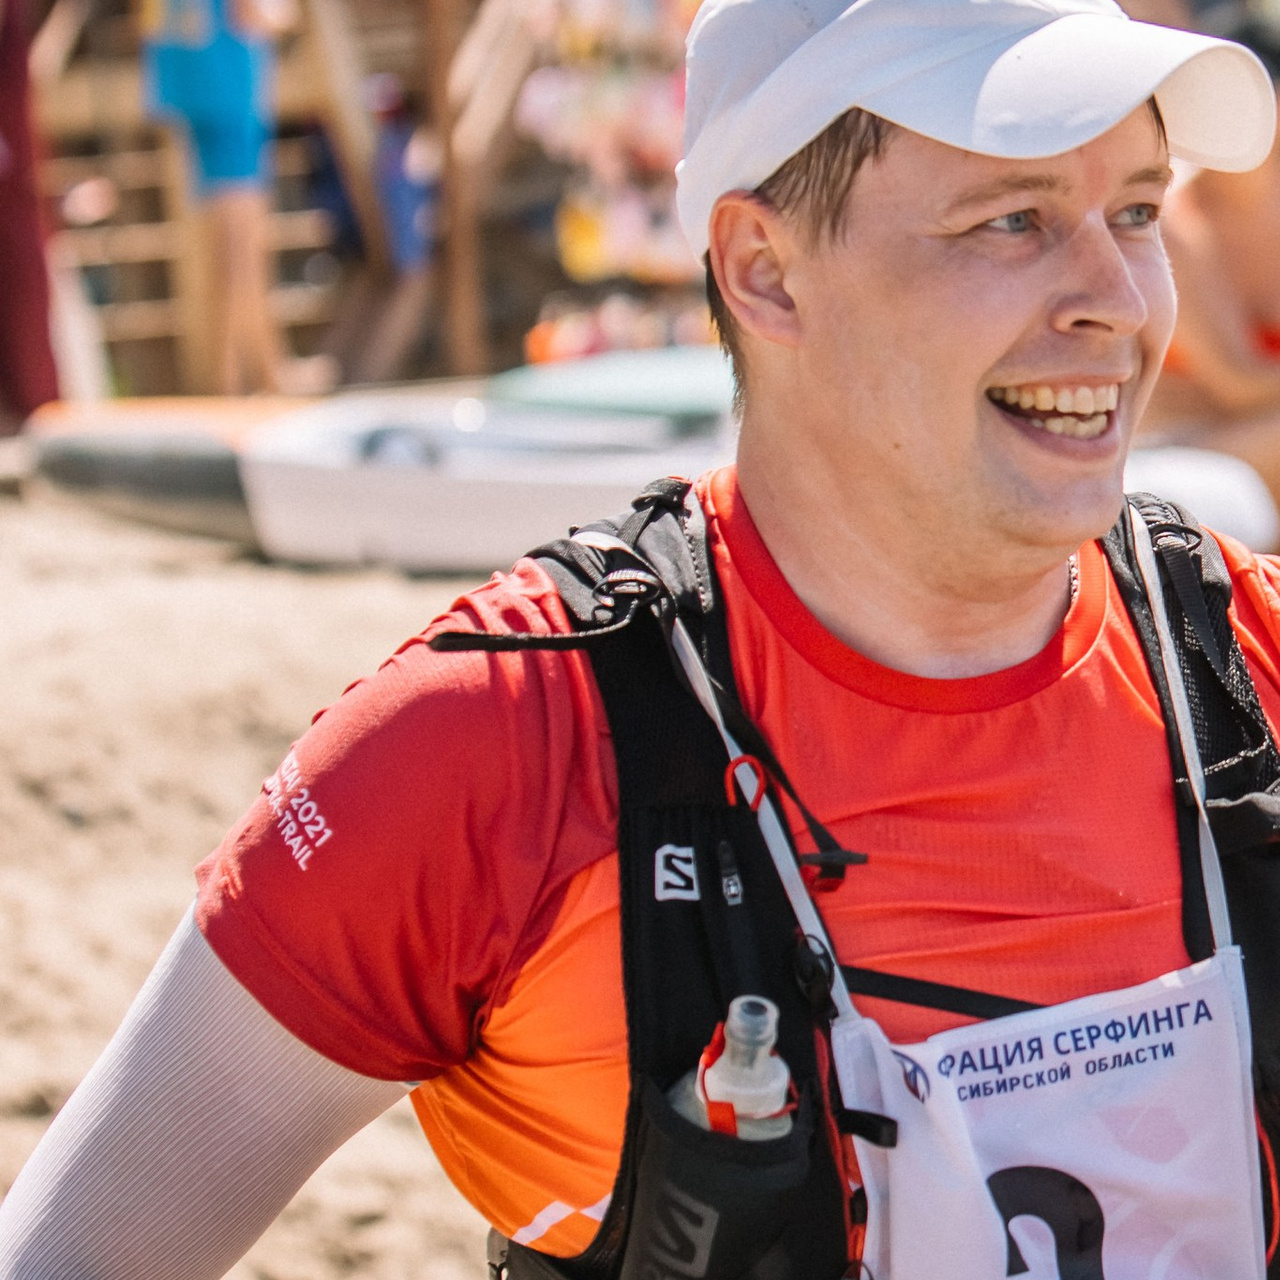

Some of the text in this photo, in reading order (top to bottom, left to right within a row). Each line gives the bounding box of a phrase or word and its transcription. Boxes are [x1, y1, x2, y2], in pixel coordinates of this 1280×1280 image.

[290, 788, 333, 848] 2021
[1053, 998, 1213, 1056] СЕРФИНГА
[956, 1041, 1175, 1102] СИБИРСКОЙ ОБЛАСТИ
